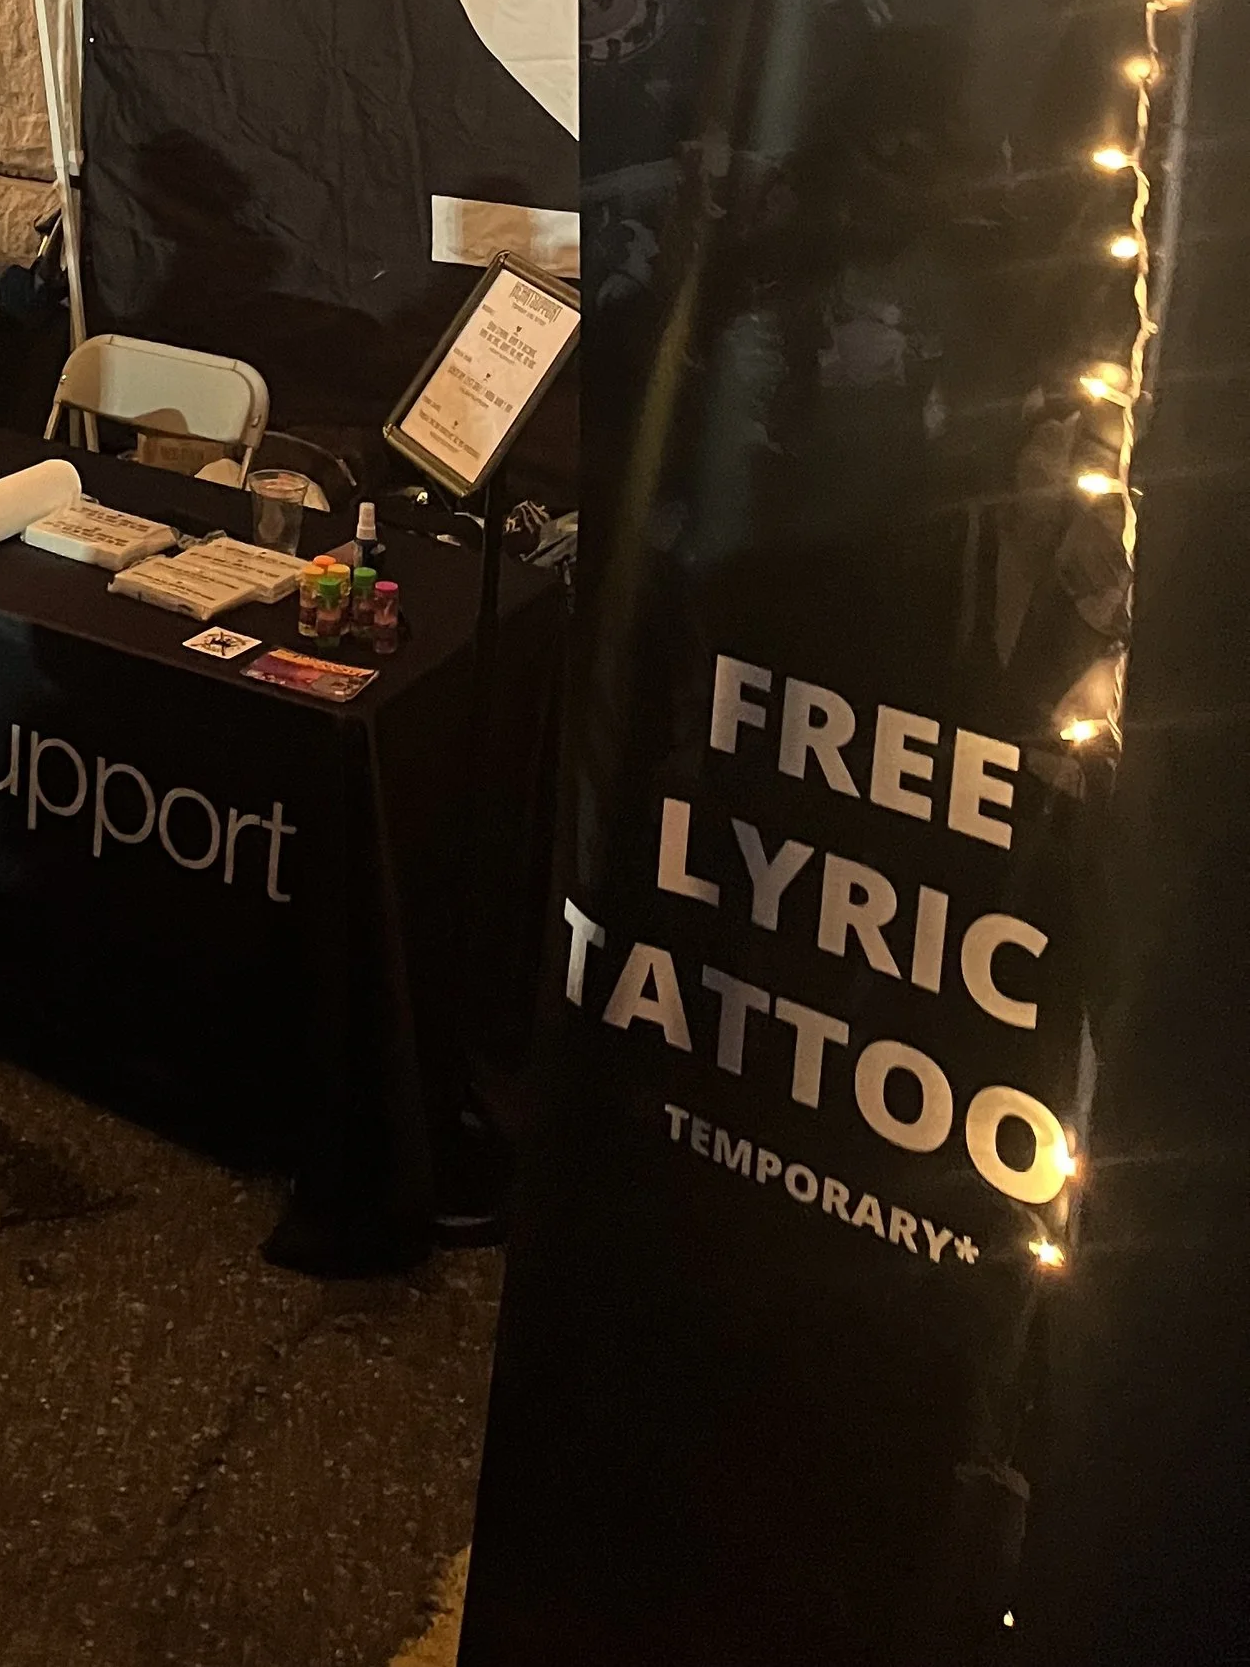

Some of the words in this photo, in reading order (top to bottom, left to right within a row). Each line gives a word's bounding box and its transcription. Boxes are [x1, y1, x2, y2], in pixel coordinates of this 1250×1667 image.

[710, 653, 1021, 851] FREE
[657, 797, 1049, 1031] LYRIC
[563, 897, 1073, 1205] TATTOO
